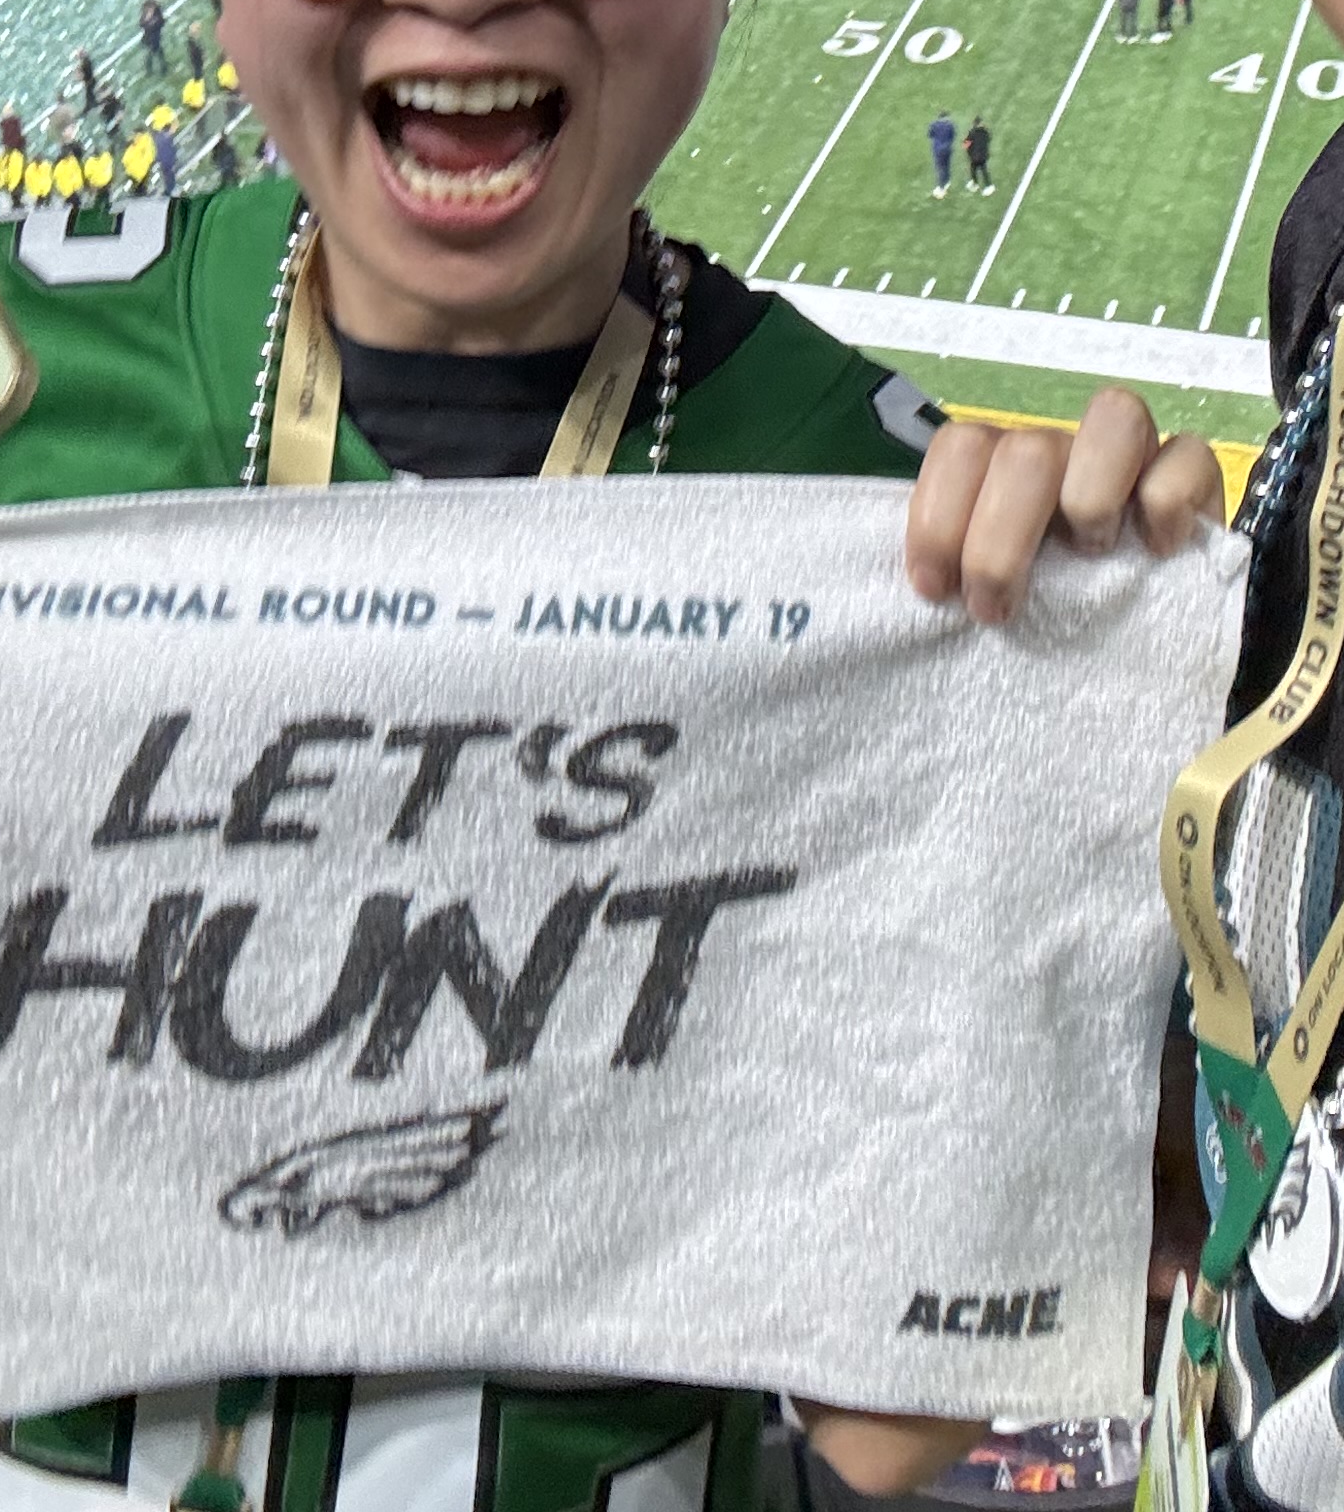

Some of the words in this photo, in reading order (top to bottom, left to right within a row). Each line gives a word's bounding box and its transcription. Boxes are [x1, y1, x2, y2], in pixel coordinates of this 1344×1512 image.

[820, 18, 964, 65] 50
[258, 584, 436, 627] ROUND
[514, 591, 742, 640] JANUARY
[768, 598, 812, 642] 19
[1267, 640, 1328, 725] CLUB
[92, 710, 681, 849] LET'S
[894, 1285, 1063, 1338] ACME
